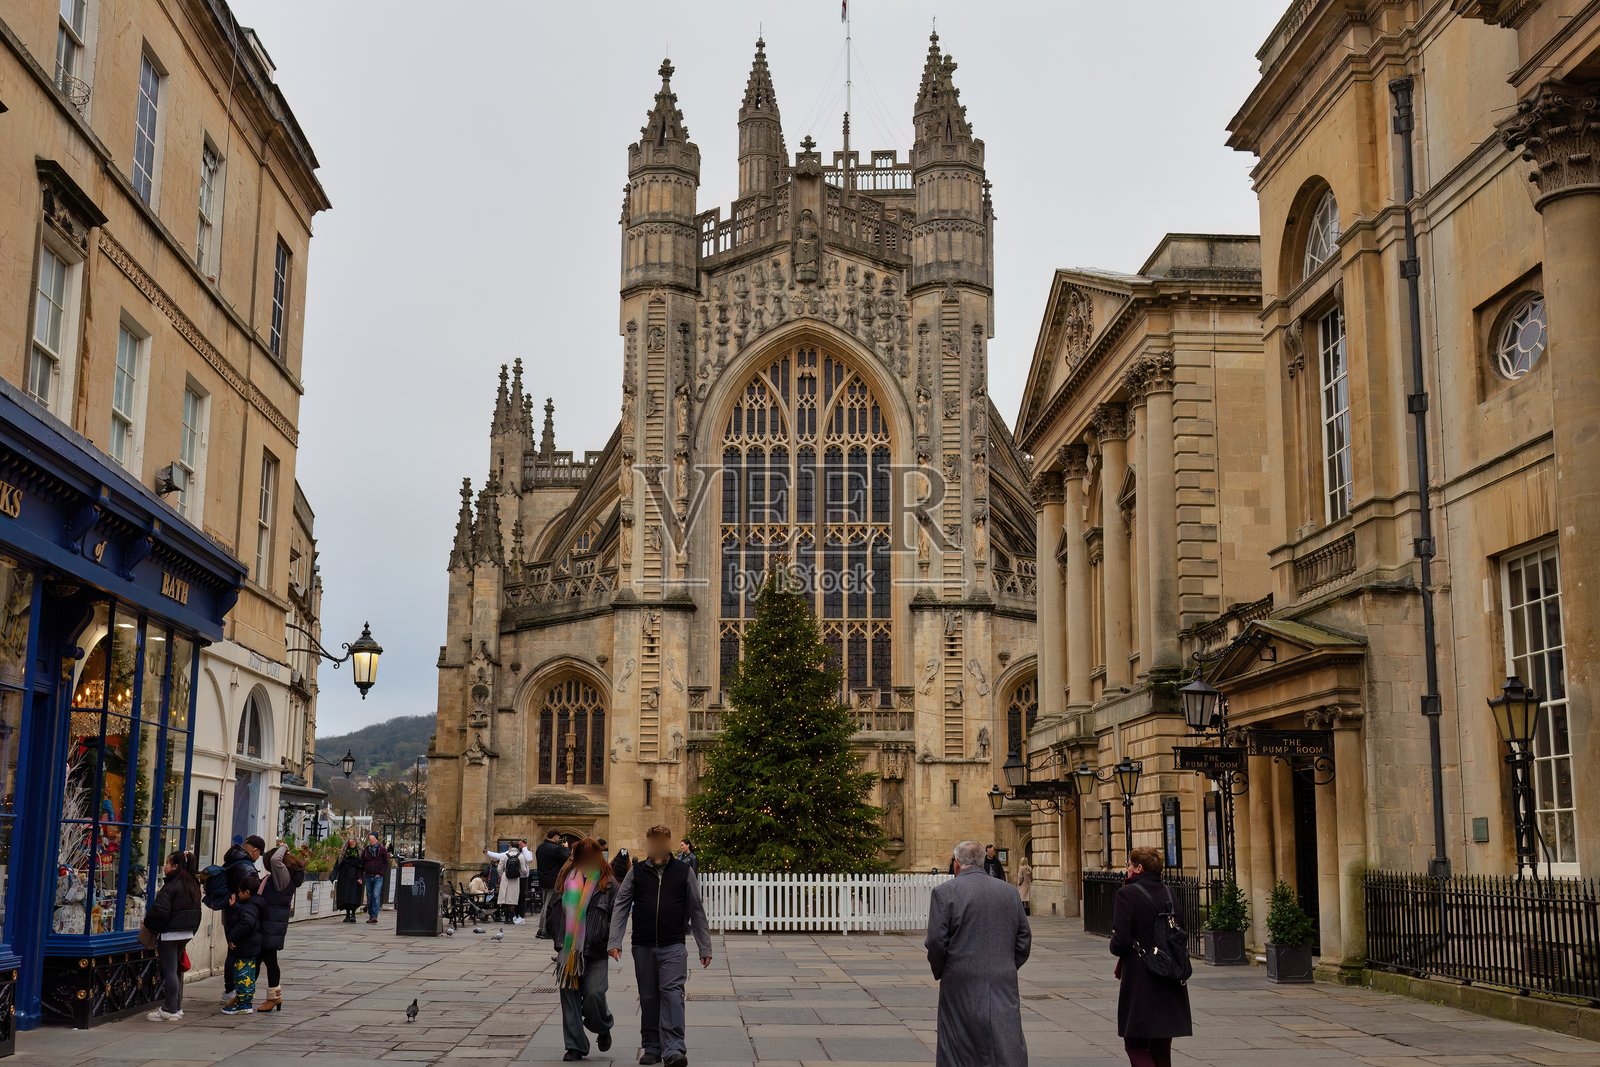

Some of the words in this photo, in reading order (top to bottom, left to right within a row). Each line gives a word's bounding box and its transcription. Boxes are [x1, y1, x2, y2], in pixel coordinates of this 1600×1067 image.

[94, 540, 108, 562] of
[161, 571, 190, 606] BATH
[1282, 738, 1302, 746] THE
[1262, 746, 1290, 754] PUMP
[1296, 746, 1324, 754] ROOM
[1203, 754, 1220, 762] THE
[1185, 761, 1209, 769] PUMP
[1214, 761, 1239, 769] ROOM
